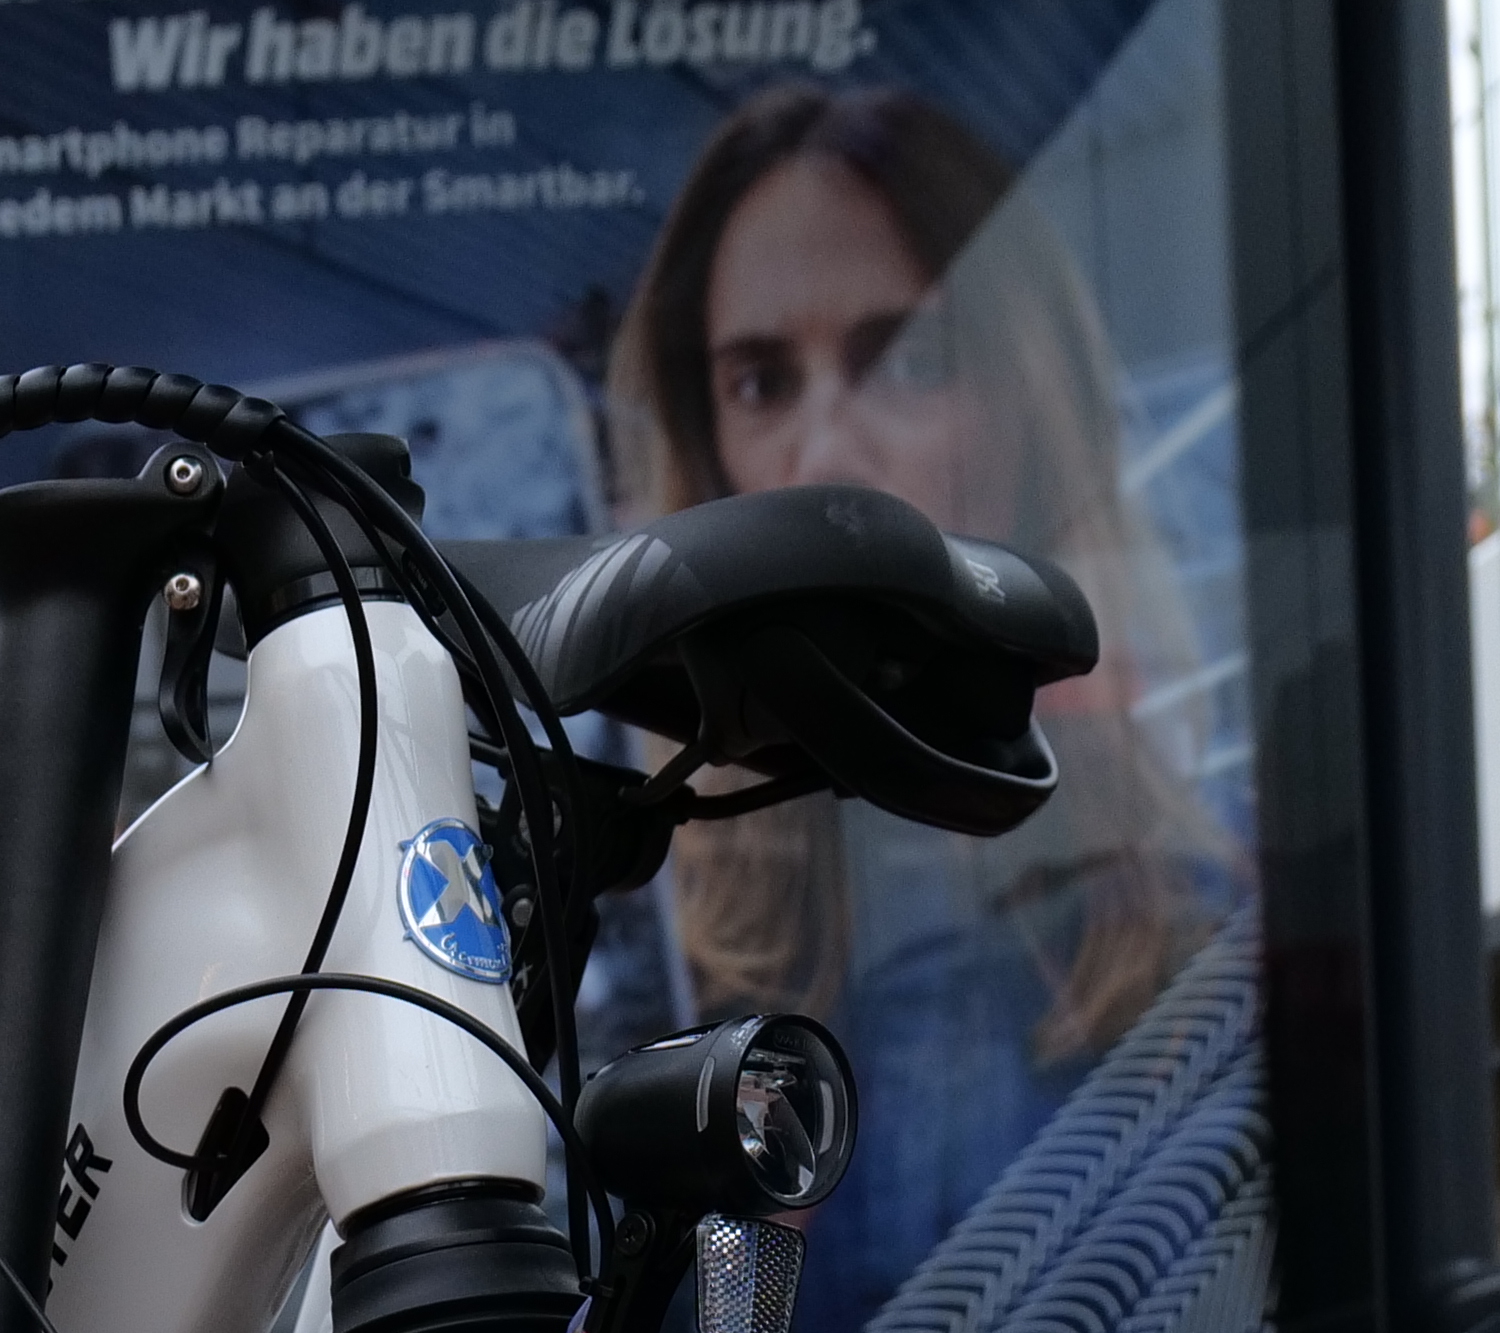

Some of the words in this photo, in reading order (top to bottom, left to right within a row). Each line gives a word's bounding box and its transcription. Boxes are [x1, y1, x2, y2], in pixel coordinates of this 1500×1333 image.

[107, 10, 243, 93] Wir
[246, 4, 477, 83] haben
[484, 0, 598, 72] die
[237, 109, 464, 162] Reparatur
[470, 102, 518, 148] in
[130, 178, 264, 228] Markt
[271, 180, 330, 219] an
[336, 168, 413, 215] der
